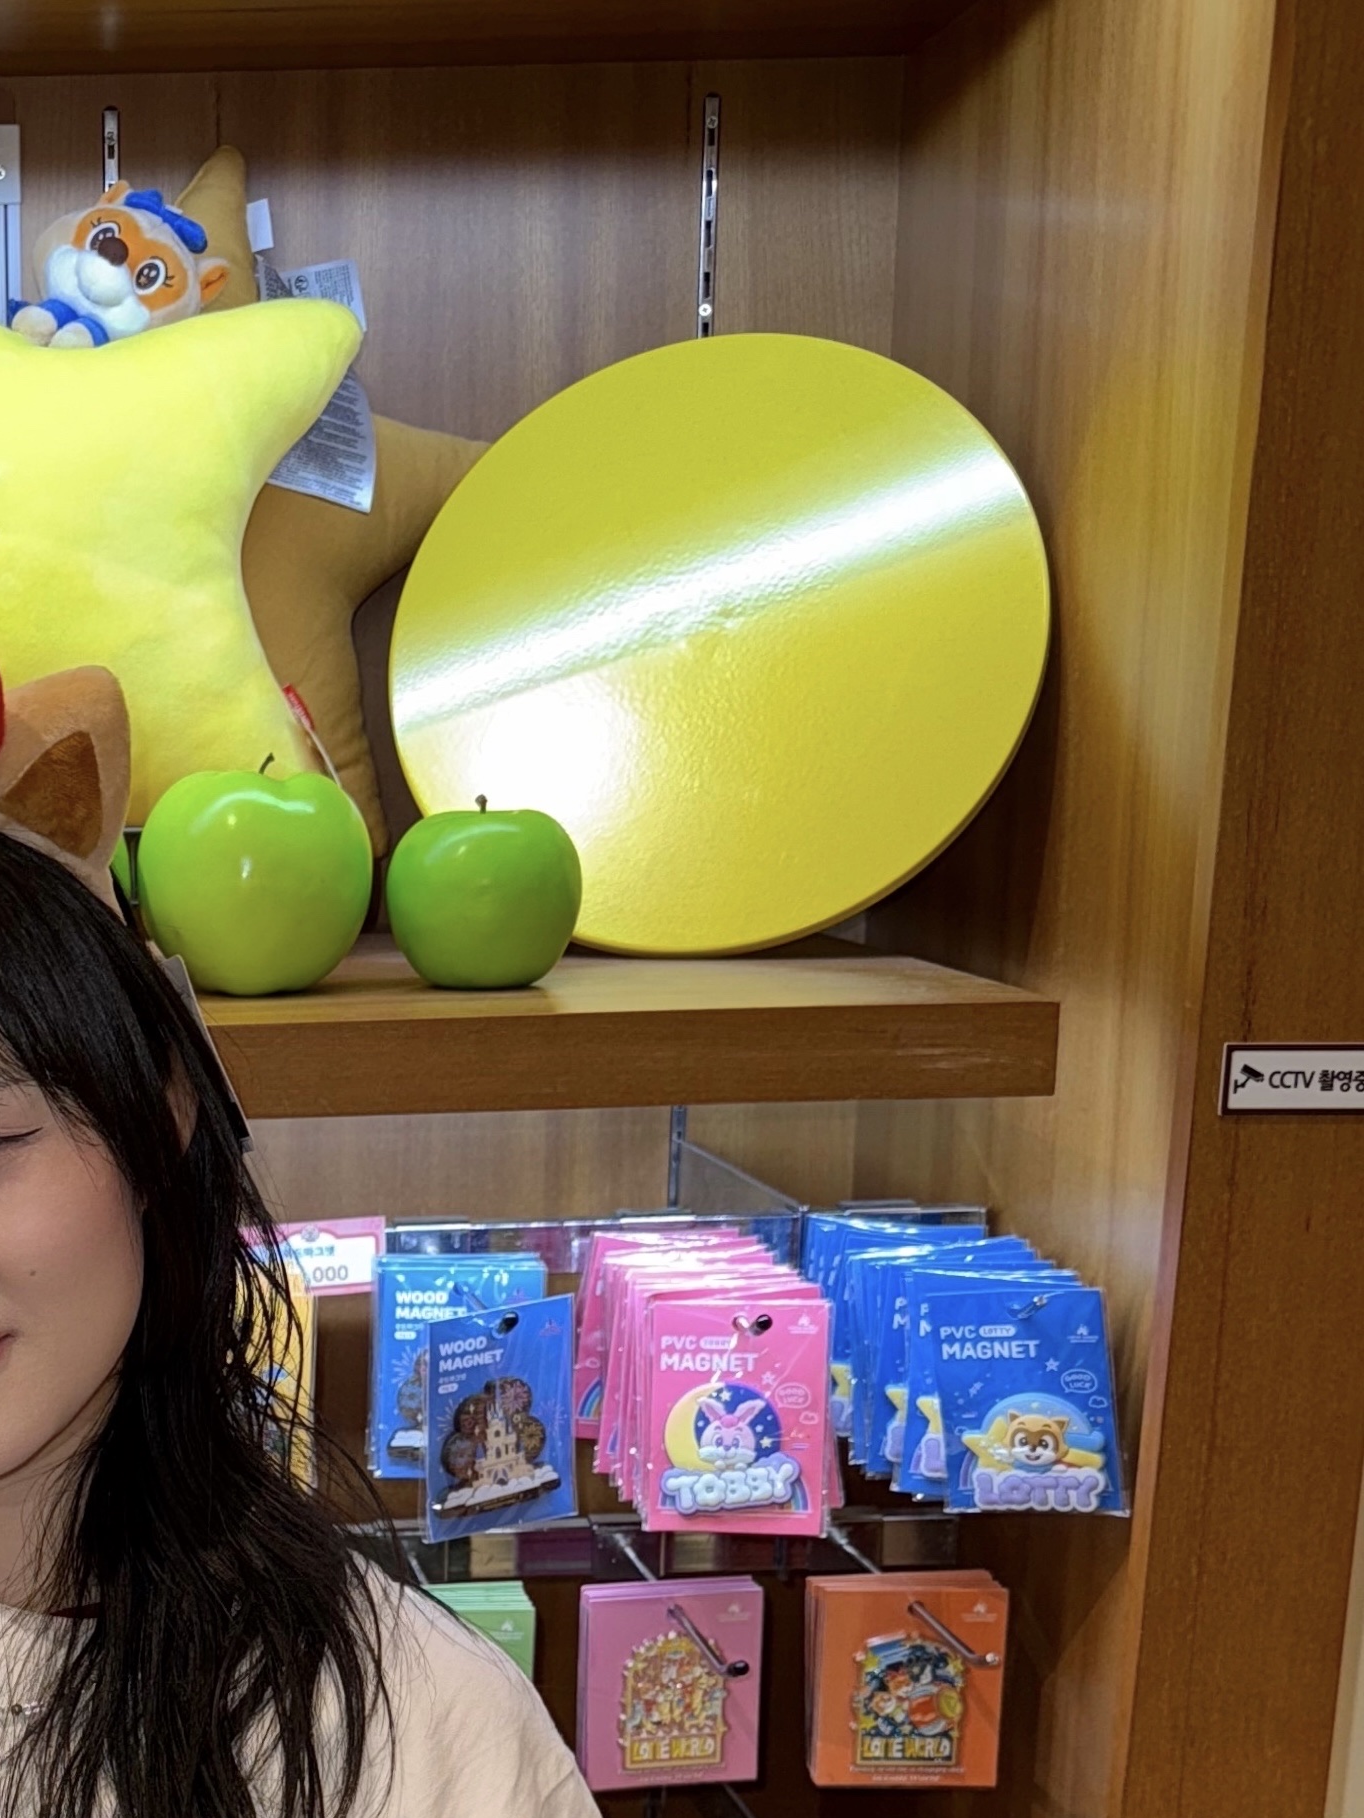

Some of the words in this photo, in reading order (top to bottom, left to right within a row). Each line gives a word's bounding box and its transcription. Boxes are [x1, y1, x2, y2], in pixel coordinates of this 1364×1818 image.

[1268, 1071, 1316, 1089] CCTV
[396, 1290, 449, 1304] WOOD
[396, 1306, 467, 1320] MAGNET
[661, 1335, 697, 1350] PVC
[940, 1326, 977, 1340] PVC
[439, 1336, 488, 1357] WOOD
[941, 1340, 1040, 1360] MAGNET
[439, 1348, 504, 1373] MAGNET
[660, 1352, 759, 1372] MAGNET
[665, 1463, 794, 1507] TOBBY
[975, 1473, 1100, 1511] LOTTY
